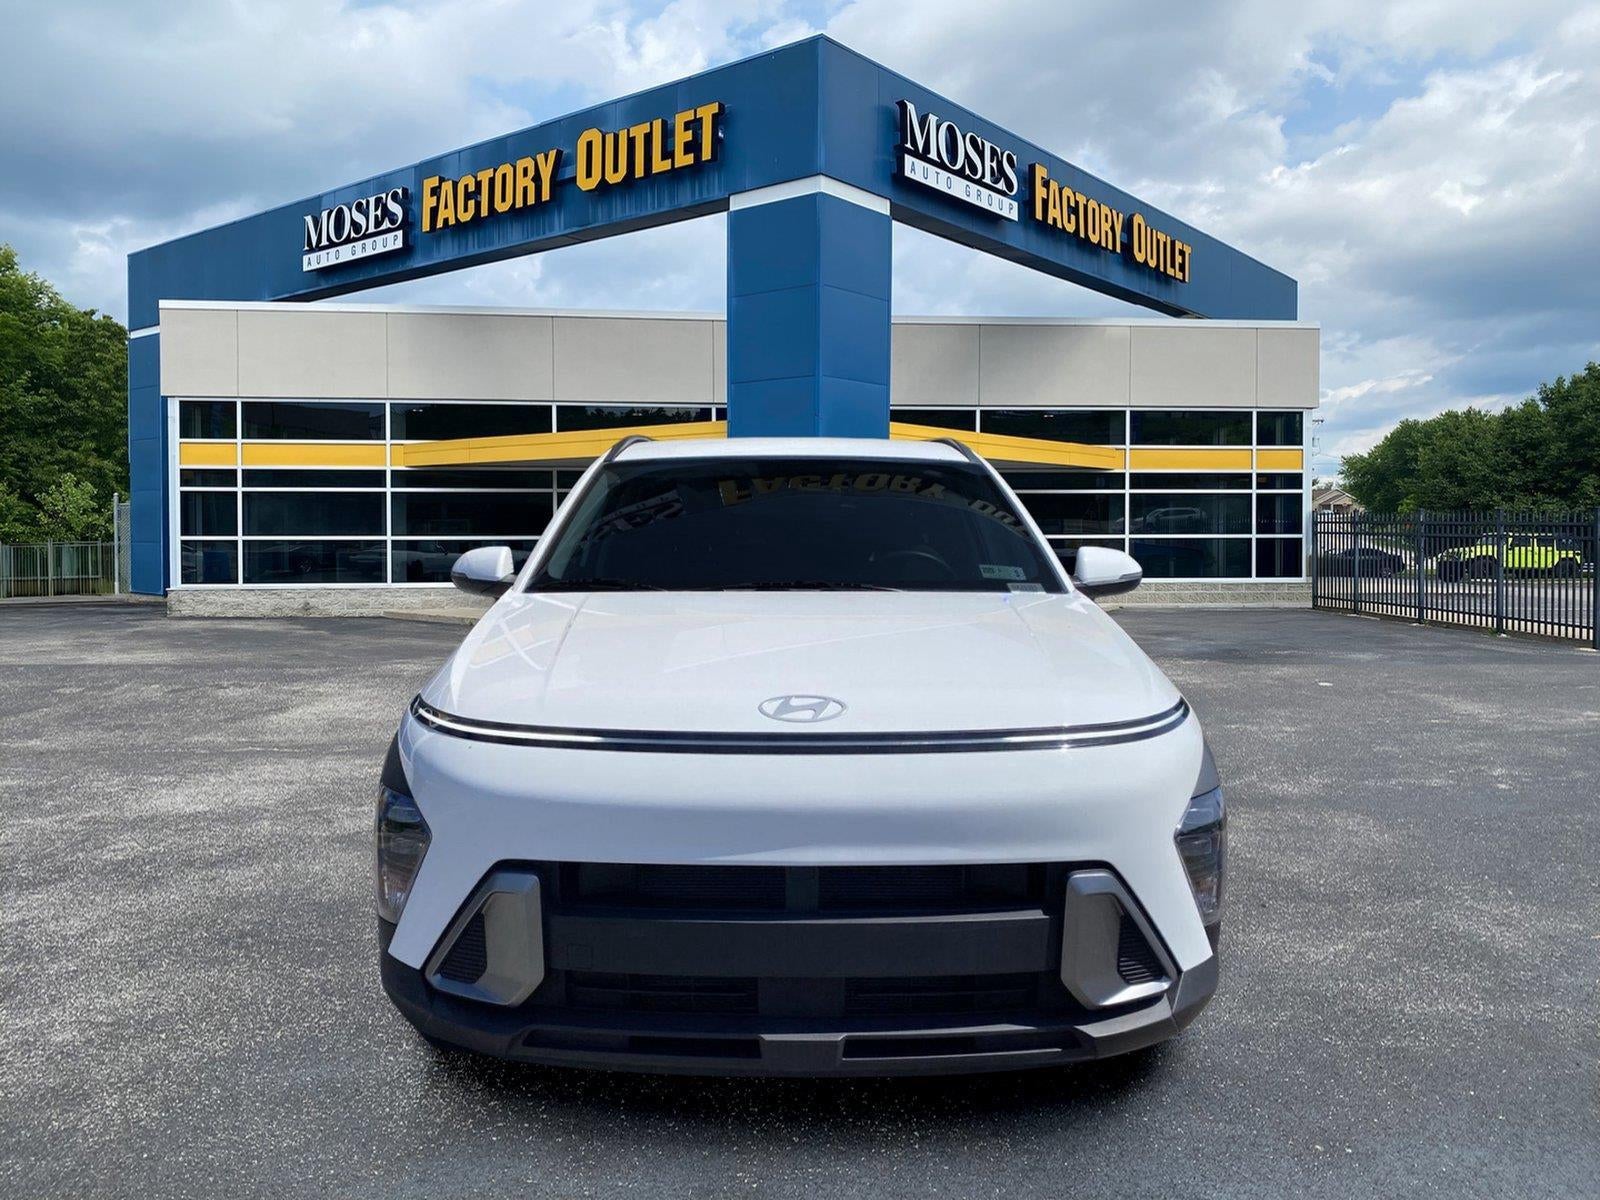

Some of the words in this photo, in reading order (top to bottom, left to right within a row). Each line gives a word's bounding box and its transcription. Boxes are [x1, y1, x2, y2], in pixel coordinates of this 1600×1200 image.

[421, 149, 558, 233] FACTORY
[576, 102, 719, 191] OUTLET
[904, 100, 1018, 195] MOSES
[303, 188, 403, 250] MOSES
[909, 161, 953, 190] AUTO
[965, 184, 1014, 214] GROUP
[1034, 163, 1124, 253] FACTORY
[1132, 213, 1191, 283] OUTLET
[307, 250, 340, 267] AUTO
[350, 235, 399, 256] GROUP
